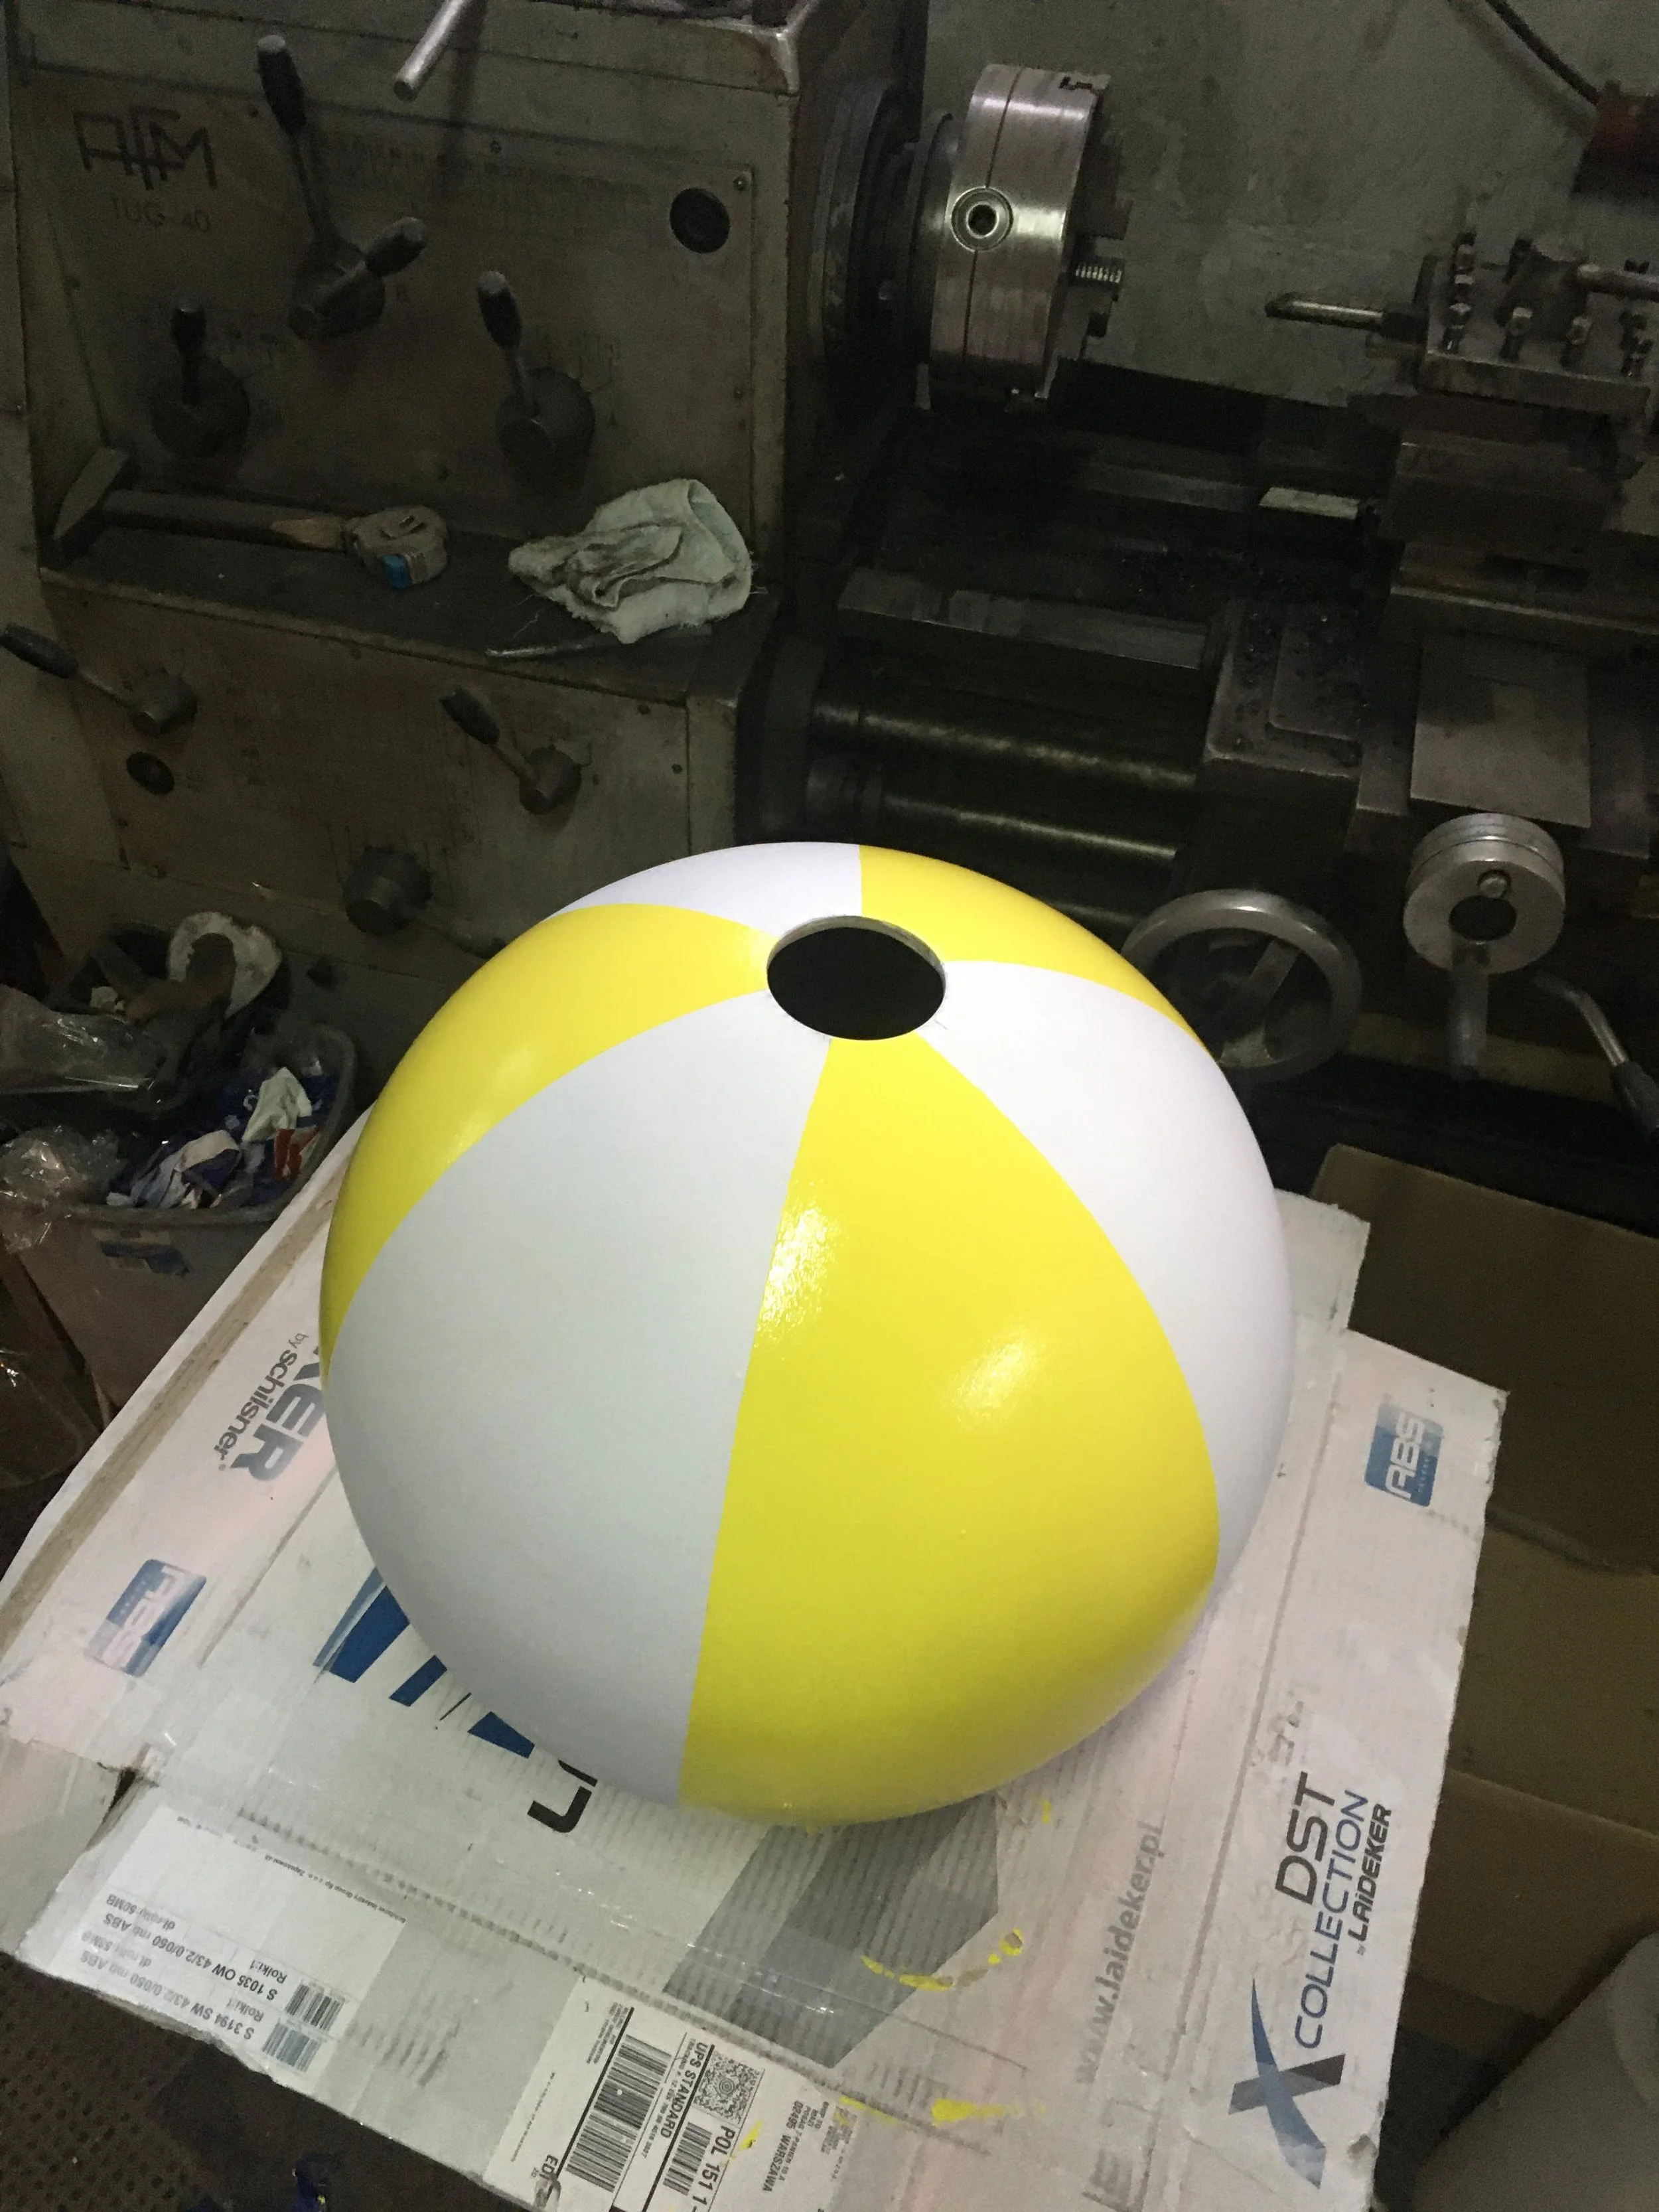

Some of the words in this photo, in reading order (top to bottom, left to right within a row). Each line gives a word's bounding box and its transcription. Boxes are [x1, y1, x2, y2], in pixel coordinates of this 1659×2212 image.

[287, 1329, 309, 1351] by
[209, 1347, 304, 1463] schilsner
[1384, 1411, 1426, 1499] ABS
[1274, 1770, 1336, 1905] DST
[102, 1911, 132, 1935] ABS
[1292, 1789, 1370, 2051] COLLECTION
[210, 1960, 237, 1982] OW
[265, 1987, 278, 2002] S
[189, 2000, 214, 2022] SW
[212, 2011, 244, 2035] 3194
[242, 2025, 255, 2041] S
[688, 2040, 709, 2069] UPS
[658, 2068, 697, 2140] STANDARD
[784, 2100, 804, 2130] 02495
[709, 2124, 737, 2160] POL
[696, 2160, 723, 2191] 151
[761, 2134, 791, 2193] WARSZAWA
